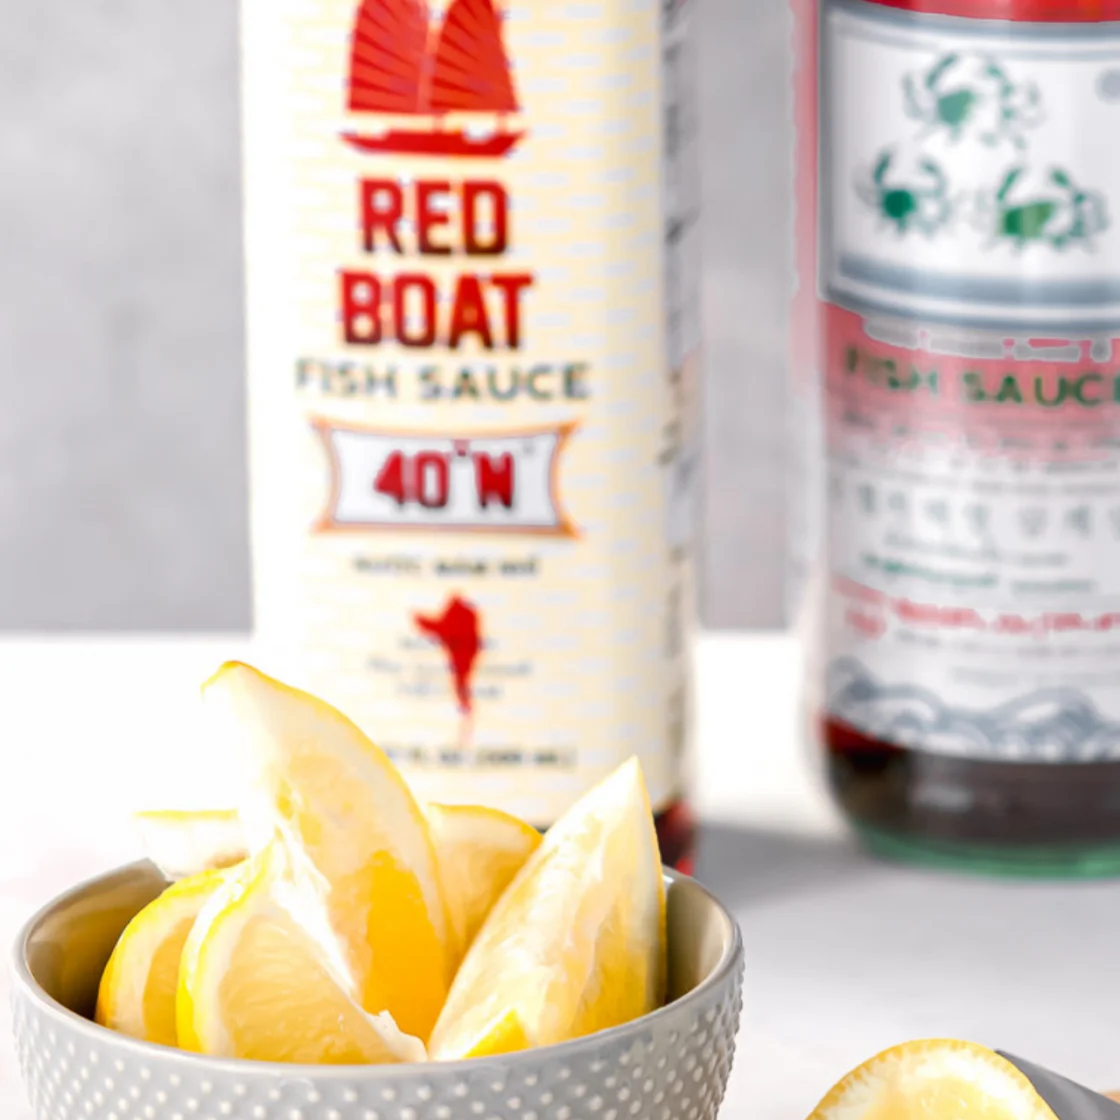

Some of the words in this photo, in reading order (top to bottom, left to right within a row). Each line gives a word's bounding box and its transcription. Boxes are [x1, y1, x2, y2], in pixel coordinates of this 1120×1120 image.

[359, 176, 509, 256] RED
[340, 268, 535, 350] BOAT
[297, 359, 398, 399] FISH
[419, 362, 592, 402] SAUCE
